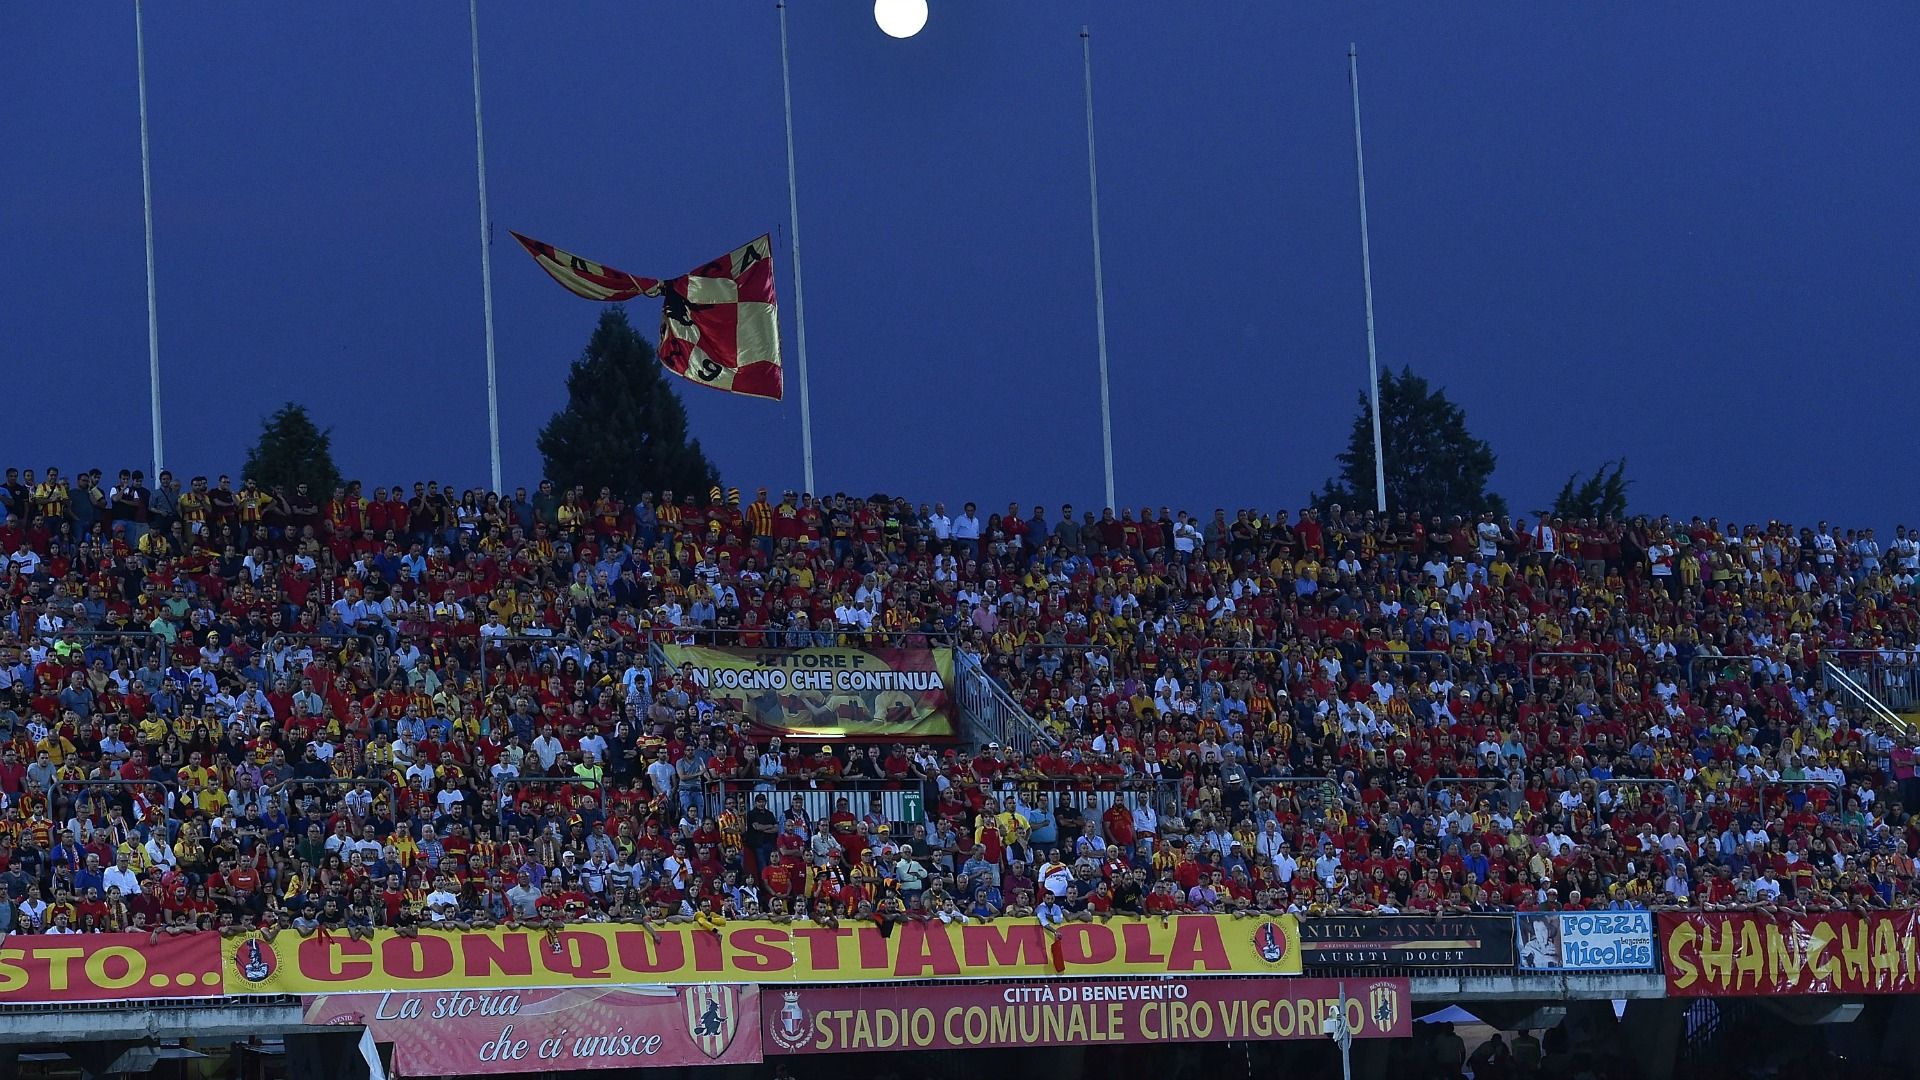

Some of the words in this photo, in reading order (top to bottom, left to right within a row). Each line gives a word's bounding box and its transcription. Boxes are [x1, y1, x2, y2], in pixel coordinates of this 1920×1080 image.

[756, 652, 847, 668] SETTORE
[853, 654, 865, 668] F
[713, 667, 787, 691] SOGNO
[791, 669, 835, 691] CHE
[836, 670, 945, 691] CONTINUA
[1378, 923, 1478, 937] SANNITA
[1562, 914, 1649, 937] FORZA
[297, 916, 1233, 982] CONQUISTIAMOLA
[1318, 951, 1388, 962] AURITI
[1405, 951, 1465, 962] DOCET
[375, 992, 424, 1020] La
[431, 991, 522, 1019] storia
[1003, 985, 1056, 1004] CITTÀ
[1058, 987, 1079, 1003] DI
[1081, 984, 1188, 1003] BENEVENTO
[815, 1007, 936, 1050] STADIO
[942, 1003, 1125, 1046] COMUNALE
[1139, 1000, 1214, 1040] CIRO
[479, 1022, 530, 1062] che
[538, 1026, 565, 1058] ci
[572, 1027, 664, 1058] unisce
